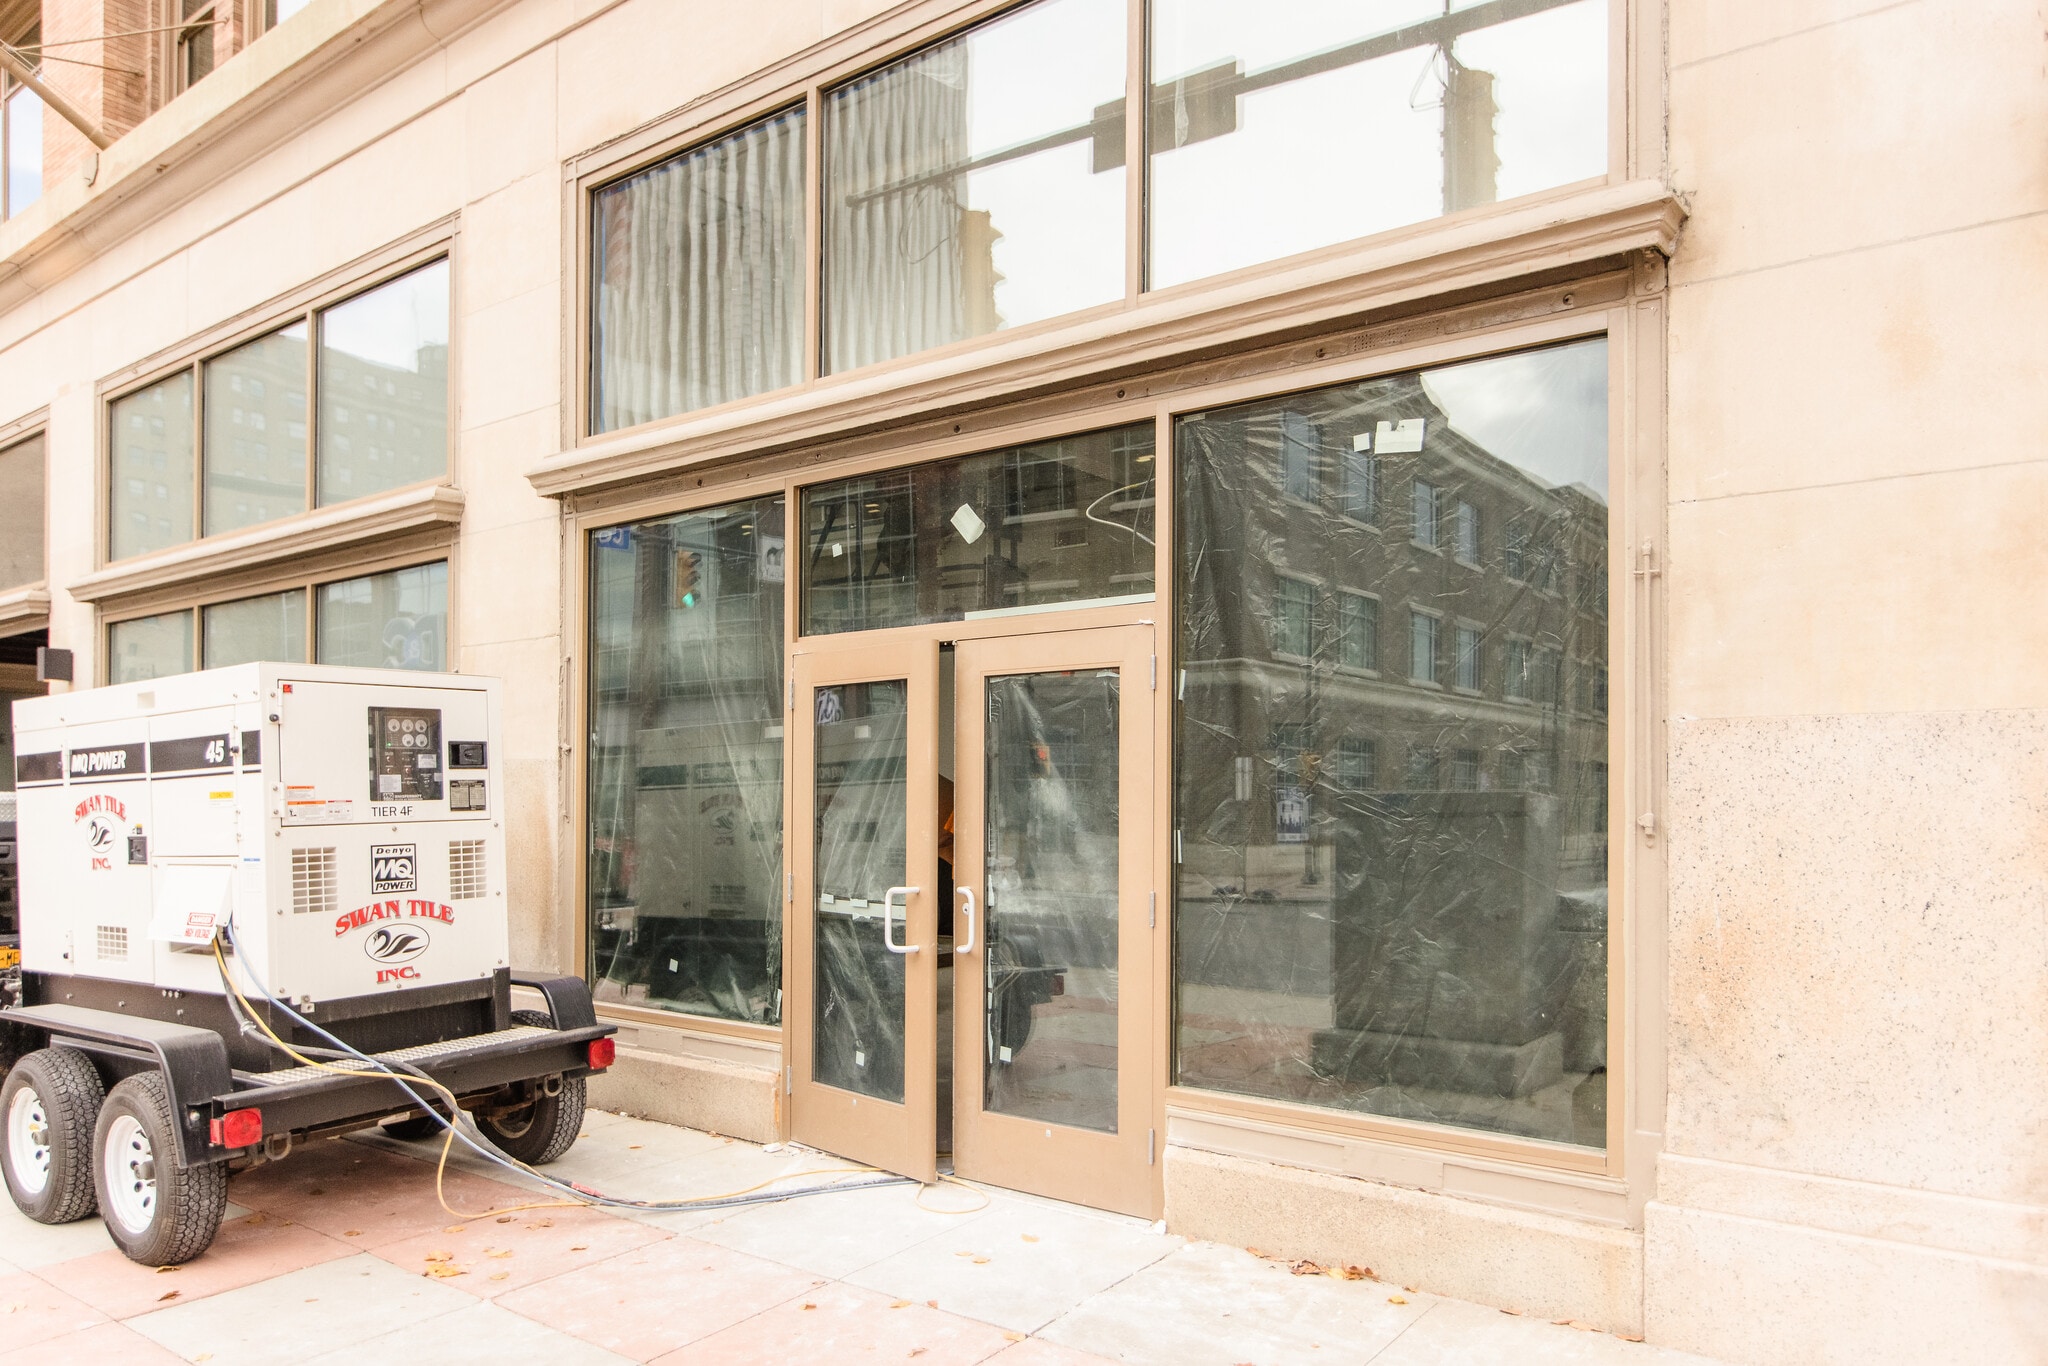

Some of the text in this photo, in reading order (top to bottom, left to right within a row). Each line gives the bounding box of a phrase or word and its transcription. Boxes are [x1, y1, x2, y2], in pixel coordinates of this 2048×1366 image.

[205, 739, 225, 763] 45
[71, 750, 127, 774] MQ POWER
[74, 794, 127, 824] SWAN TILE
[371, 806, 413, 817] TIER 4F
[376, 847, 412, 855] Denyo
[92, 858, 112, 871] INC.
[375, 858, 413, 879] MQ
[375, 880, 414, 891] POWER
[335, 899, 455, 938] SWAN TILE
[376, 965, 421, 984] INC.
